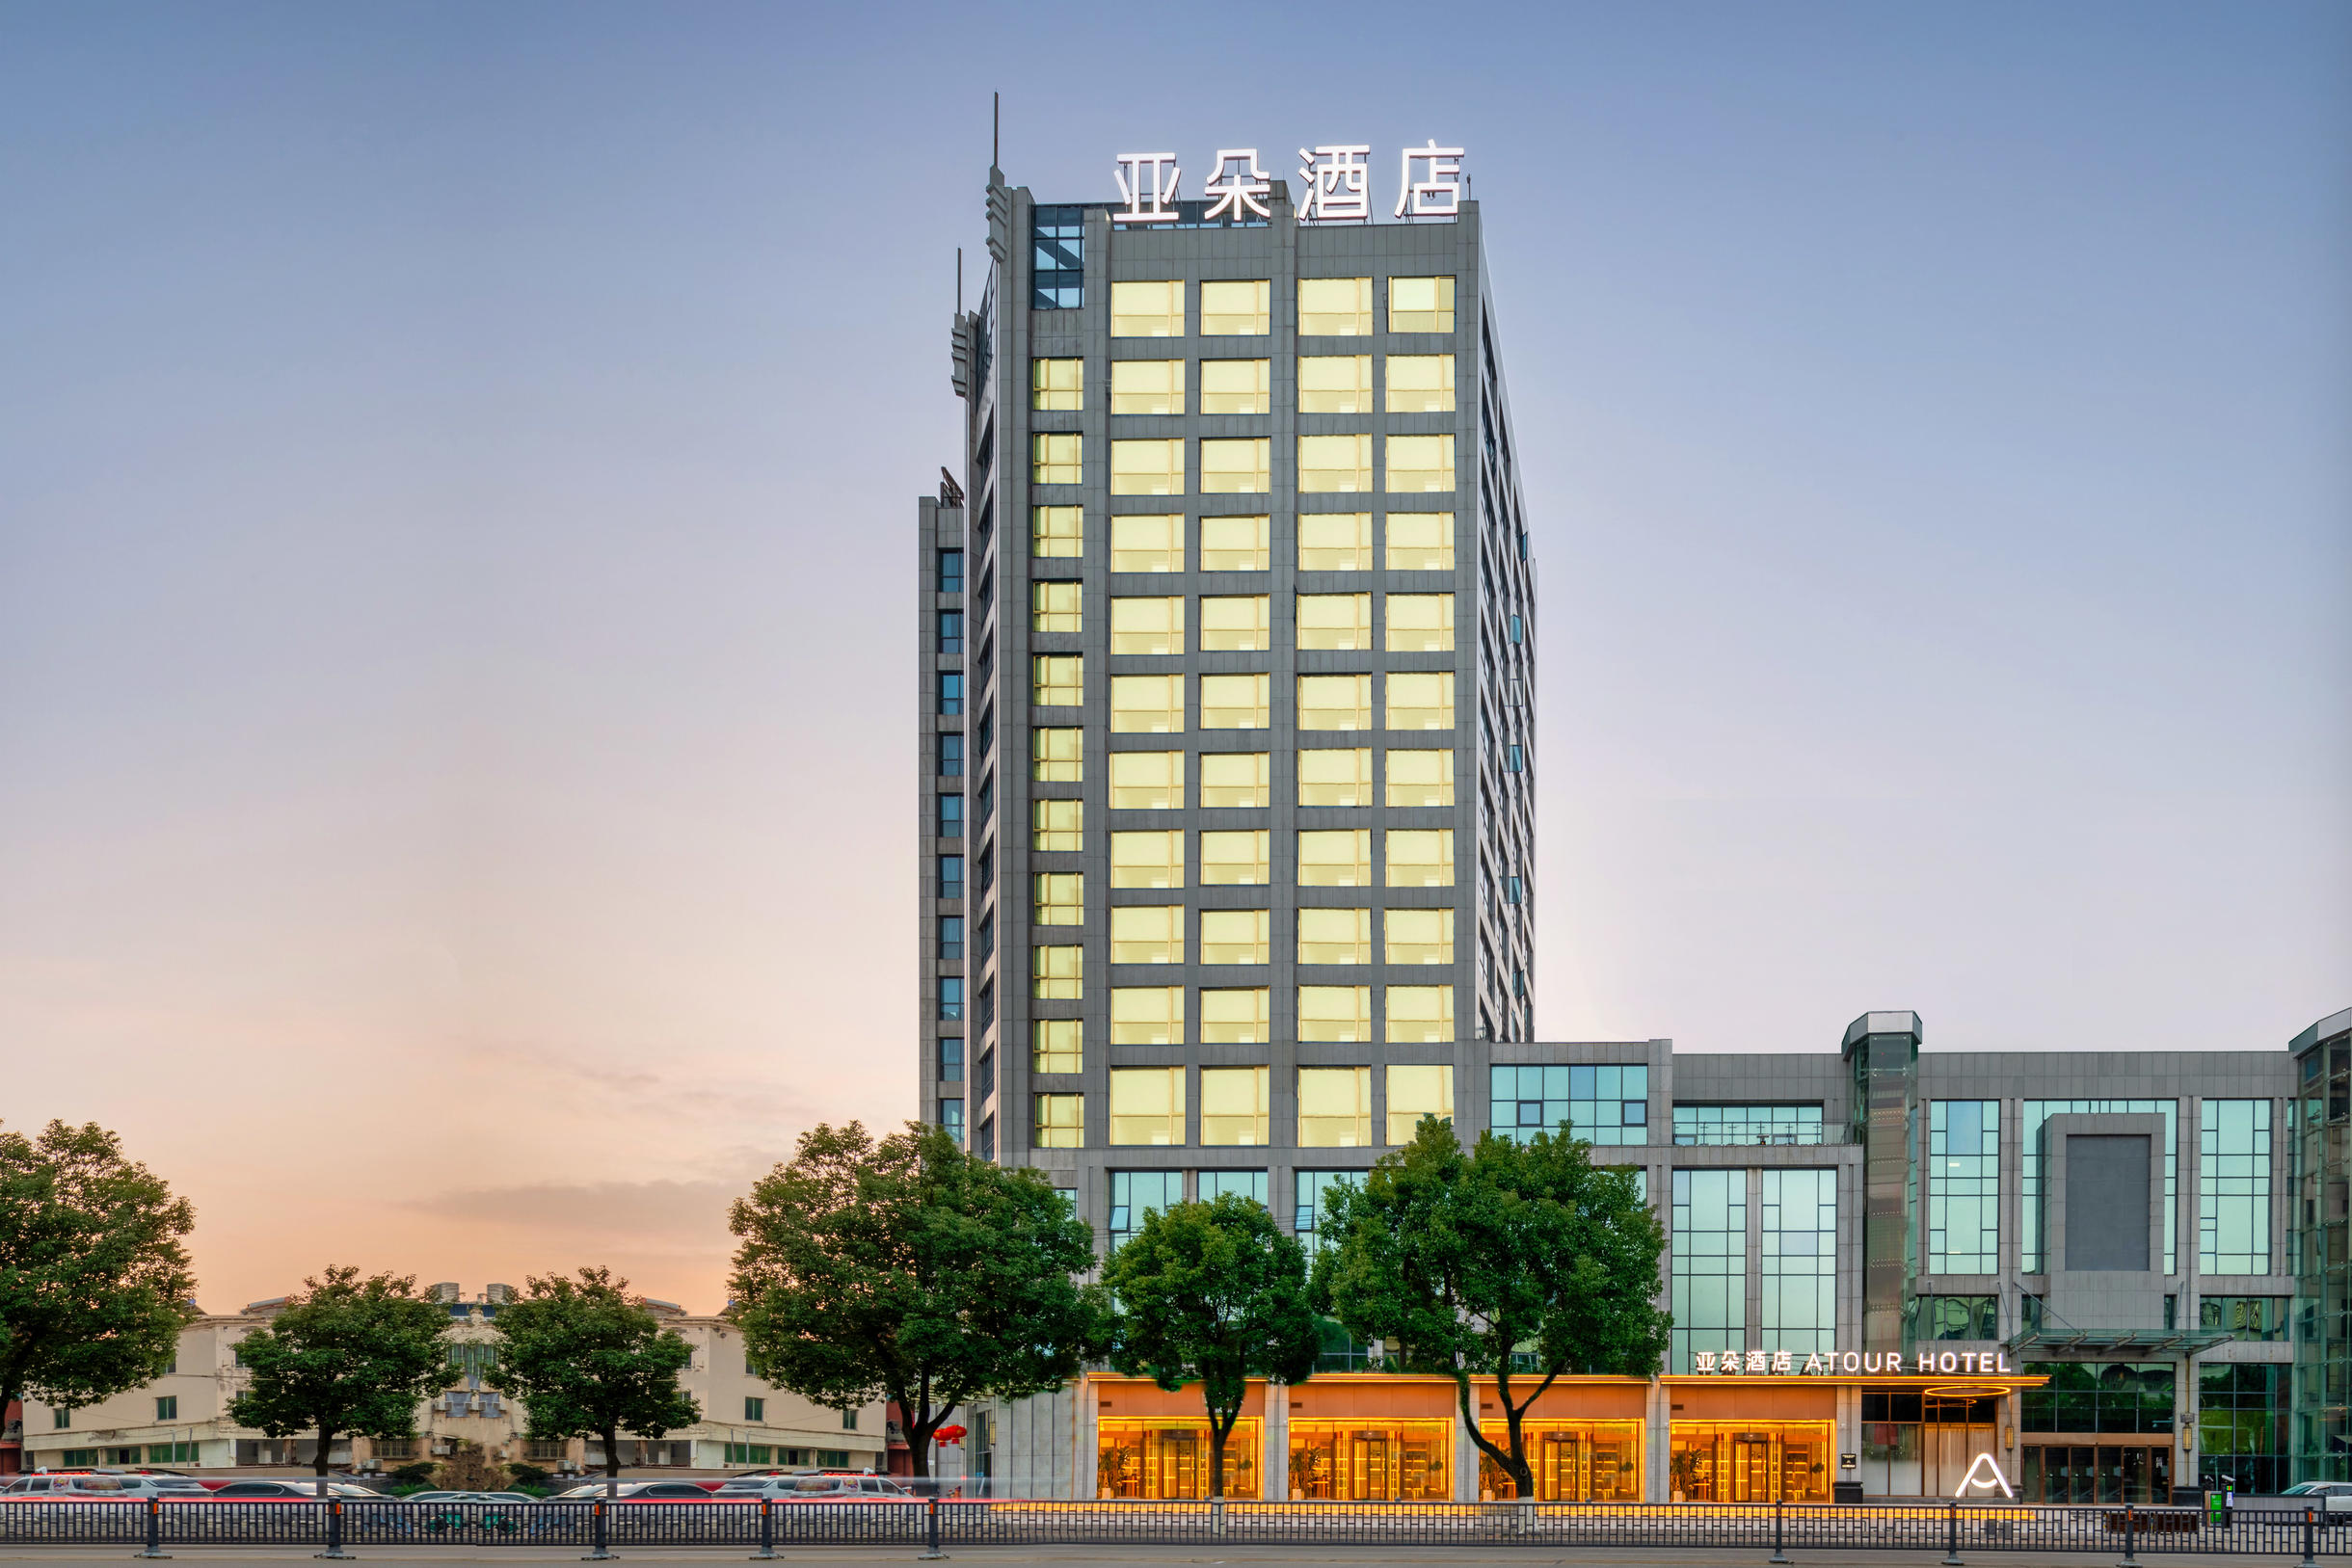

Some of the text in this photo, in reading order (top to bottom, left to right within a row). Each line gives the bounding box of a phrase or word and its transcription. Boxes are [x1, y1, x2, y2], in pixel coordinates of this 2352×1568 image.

[1112, 139, 1465, 222] 亚朵酒店
[1696, 1350, 1793, 1372] 亚朵酒店
[1804, 1351, 2012, 1373] ATOUR HOTEL
